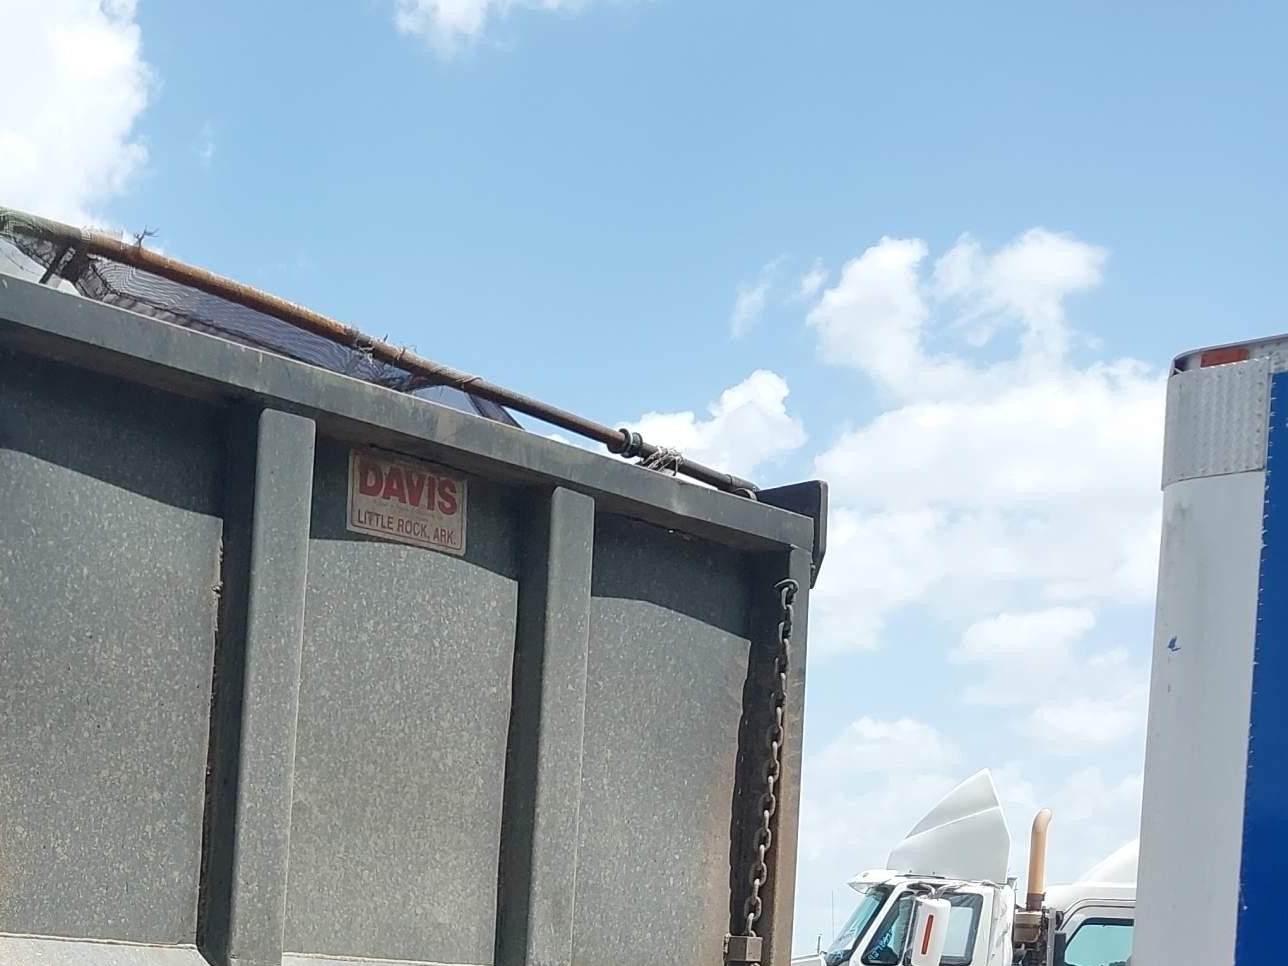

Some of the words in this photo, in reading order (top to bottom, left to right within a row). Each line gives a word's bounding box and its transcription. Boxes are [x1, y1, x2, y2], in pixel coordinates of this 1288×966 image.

[359, 456, 458, 516] DAVIS
[357, 509, 394, 530] LITTLE
[433, 528, 457, 545] ARK.
